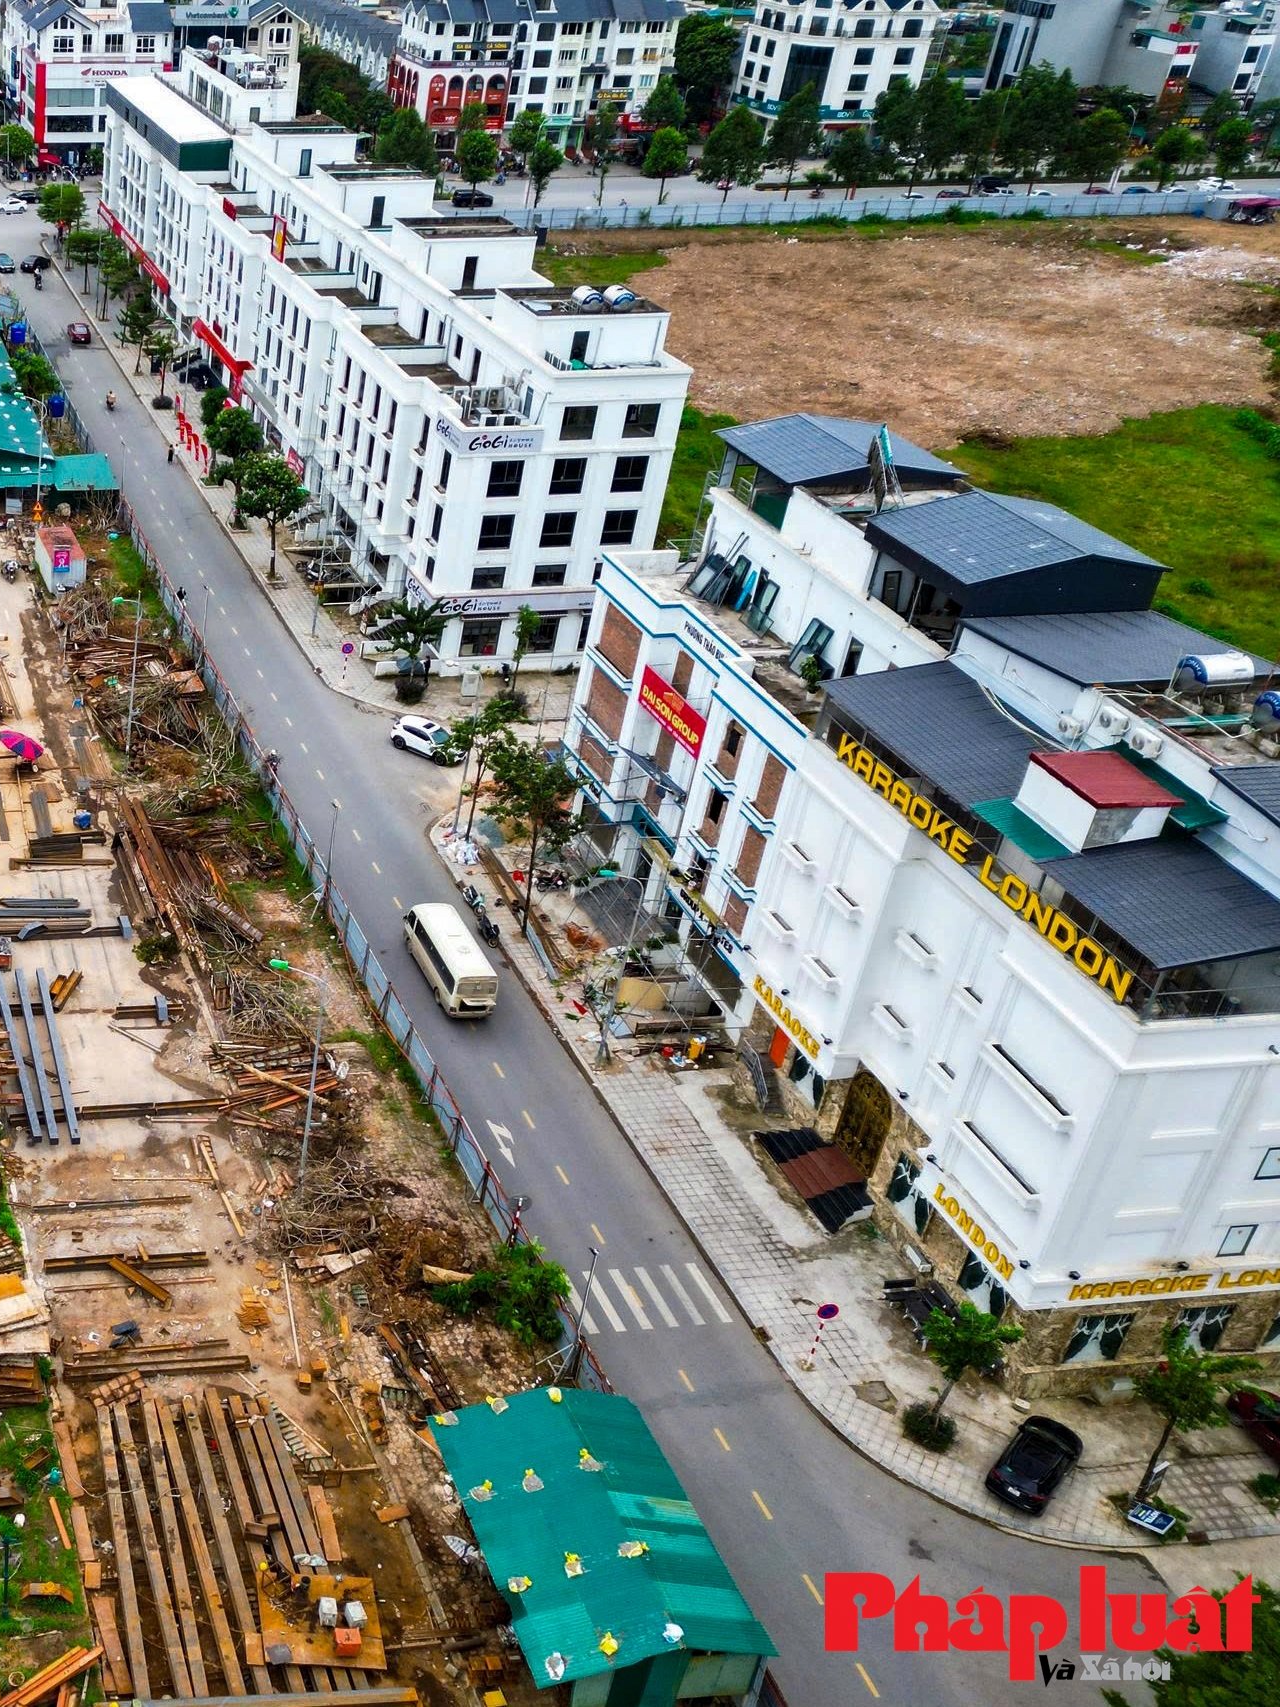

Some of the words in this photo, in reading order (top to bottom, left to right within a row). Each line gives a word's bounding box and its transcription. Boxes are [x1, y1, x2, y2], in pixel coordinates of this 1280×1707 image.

[671, 714, 699, 744] GROUP
[837, 733, 975, 865] KARAOKE
[979, 854, 1134, 1003] LONDON
[753, 974, 821, 1060] KARAOKE
[933, 1183, 1016, 1282] LONDON
[1069, 1274, 1214, 1301] KARAOKE
